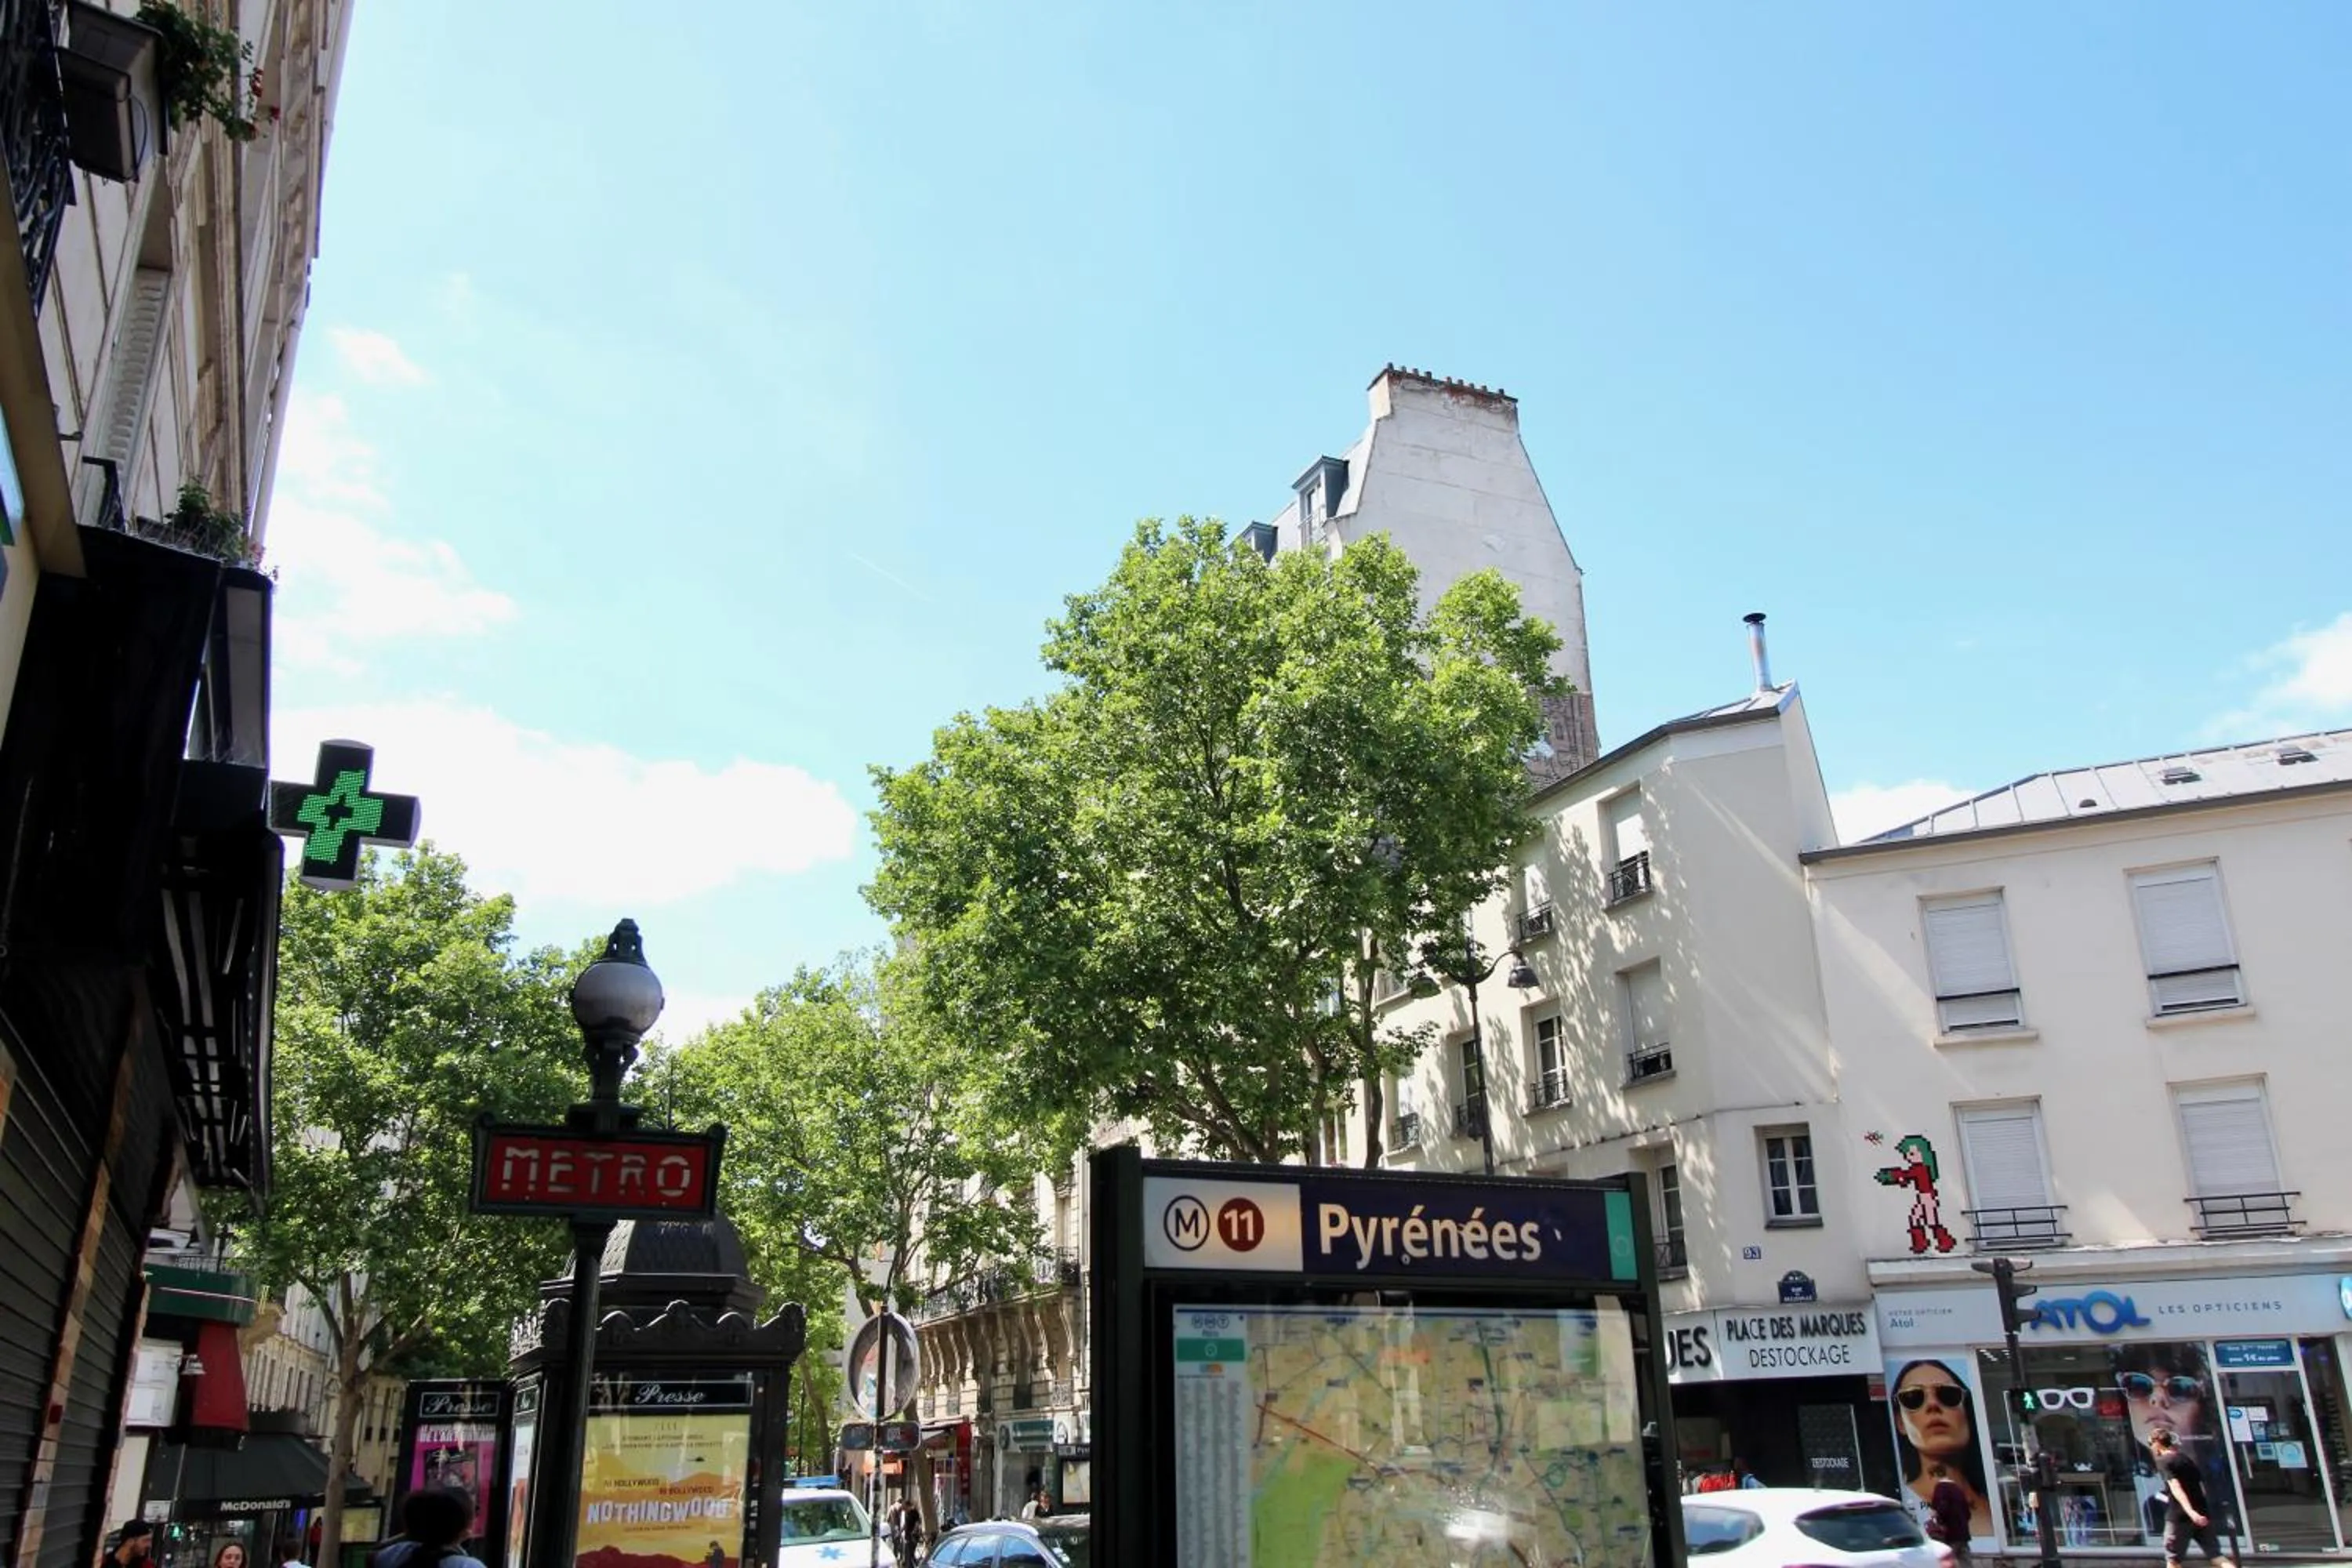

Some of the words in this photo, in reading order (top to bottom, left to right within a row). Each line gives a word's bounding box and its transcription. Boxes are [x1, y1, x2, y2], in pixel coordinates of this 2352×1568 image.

[502, 1146, 691, 1197] METRO
[1224, 1208, 1254, 1242] 11
[1319, 1204, 1541, 1270] Pyrénées
[1744, 1247, 1760, 1259] 93
[2031, 1290, 2152, 1334] ATOL
[2158, 1305, 2186, 1315] LES
[2194, 1301, 2283, 1313] OPTICIENS
[1726, 1318, 1766, 1341] PLACE
[1770, 1317, 1795, 1339] DES
[1799, 1312, 1867, 1338] MARQUES
[1889, 1317, 1915, 1329] Atol
[1749, 1345, 1851, 1368] DESTOCKAGE
[424, 1394, 493, 1414] Presse
[634, 1384, 705, 1404] Presse
[614, 1478, 659, 1487] HOLLYWOOD
[220, 1499, 291, 1512] McDonald's
[586, 1496, 729, 1525] NOTHINGWOOD
